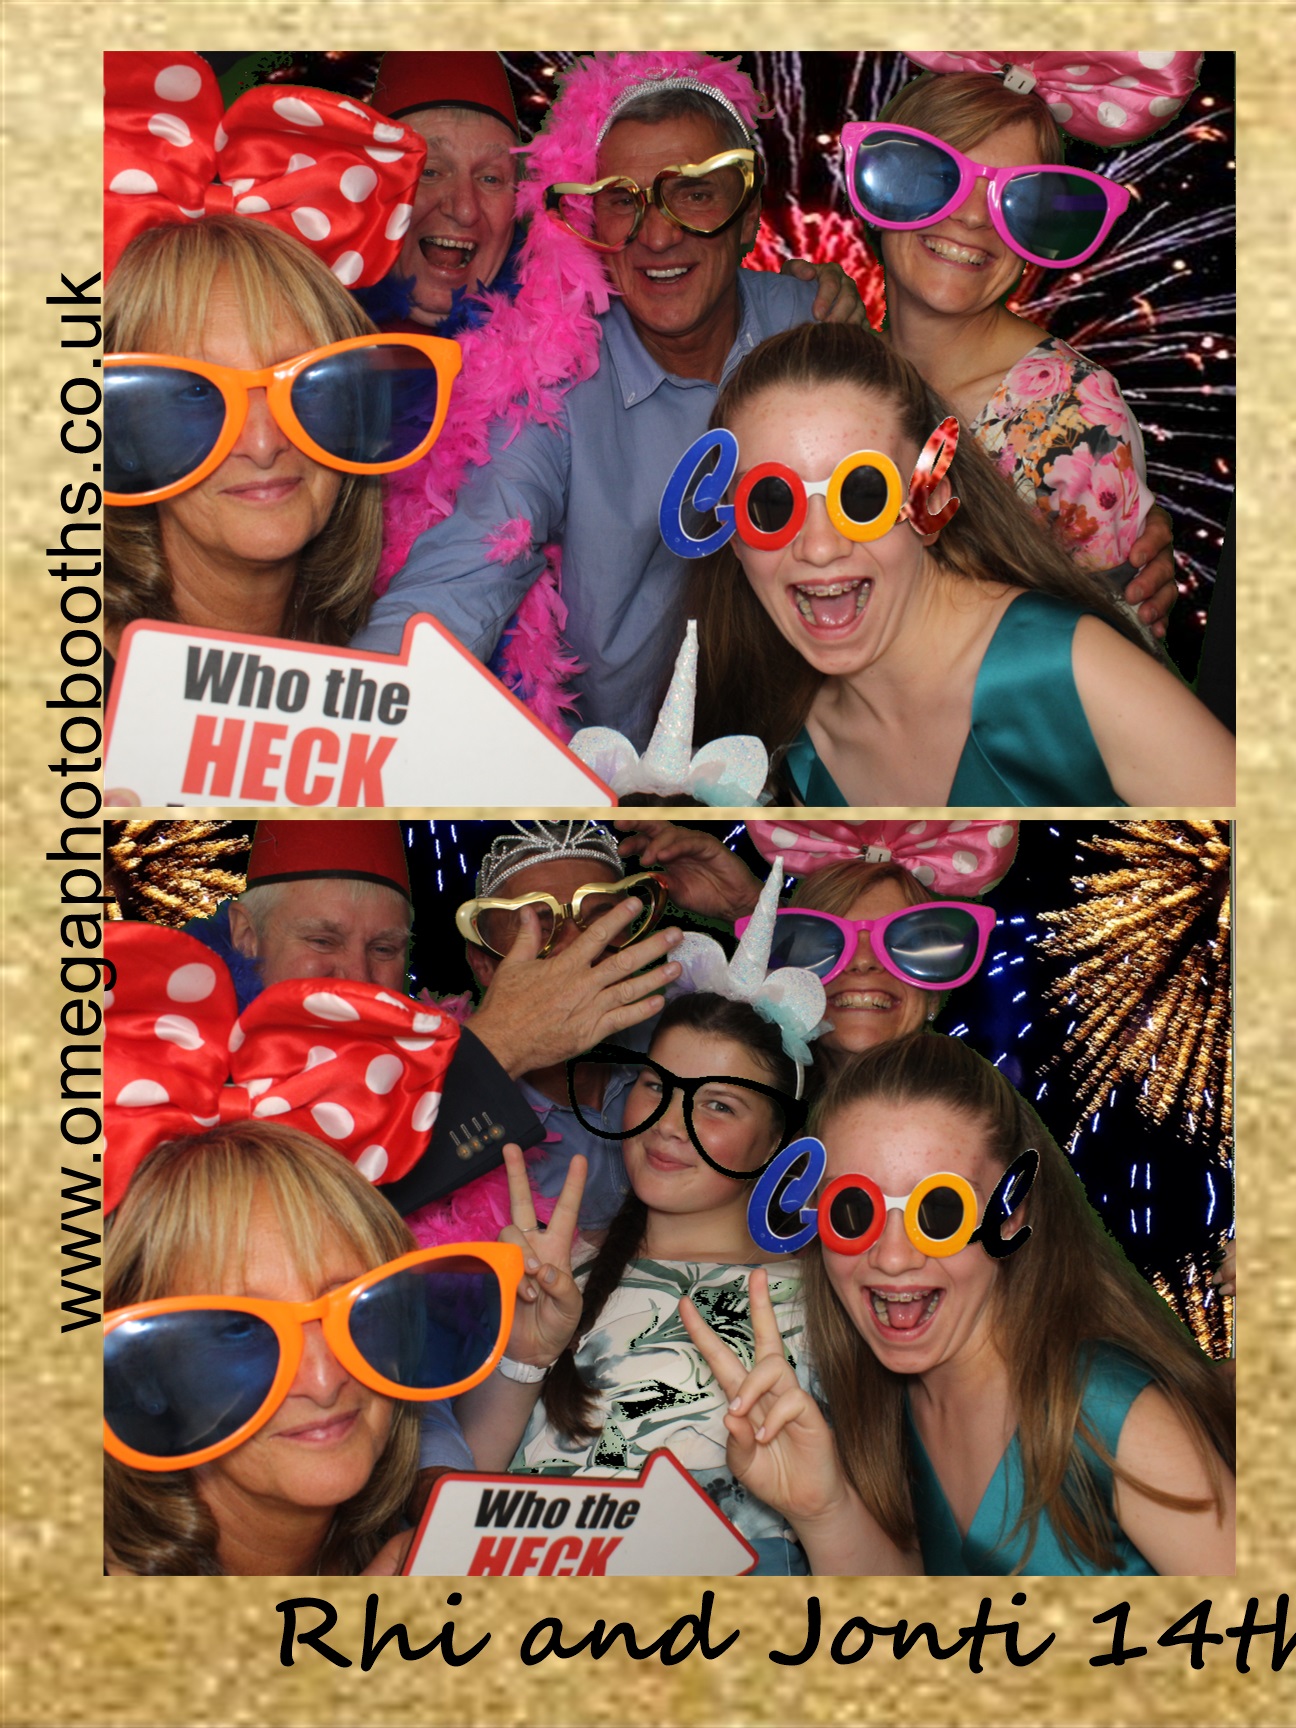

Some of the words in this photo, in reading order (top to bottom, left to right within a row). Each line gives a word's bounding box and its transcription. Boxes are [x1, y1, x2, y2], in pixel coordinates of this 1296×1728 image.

[184, 645, 310, 713] Who
[323, 668, 410, 725] the
[181, 714, 398, 807] HECK
[474, 1488, 571, 1529] Who
[574, 1493, 641, 1530] the
